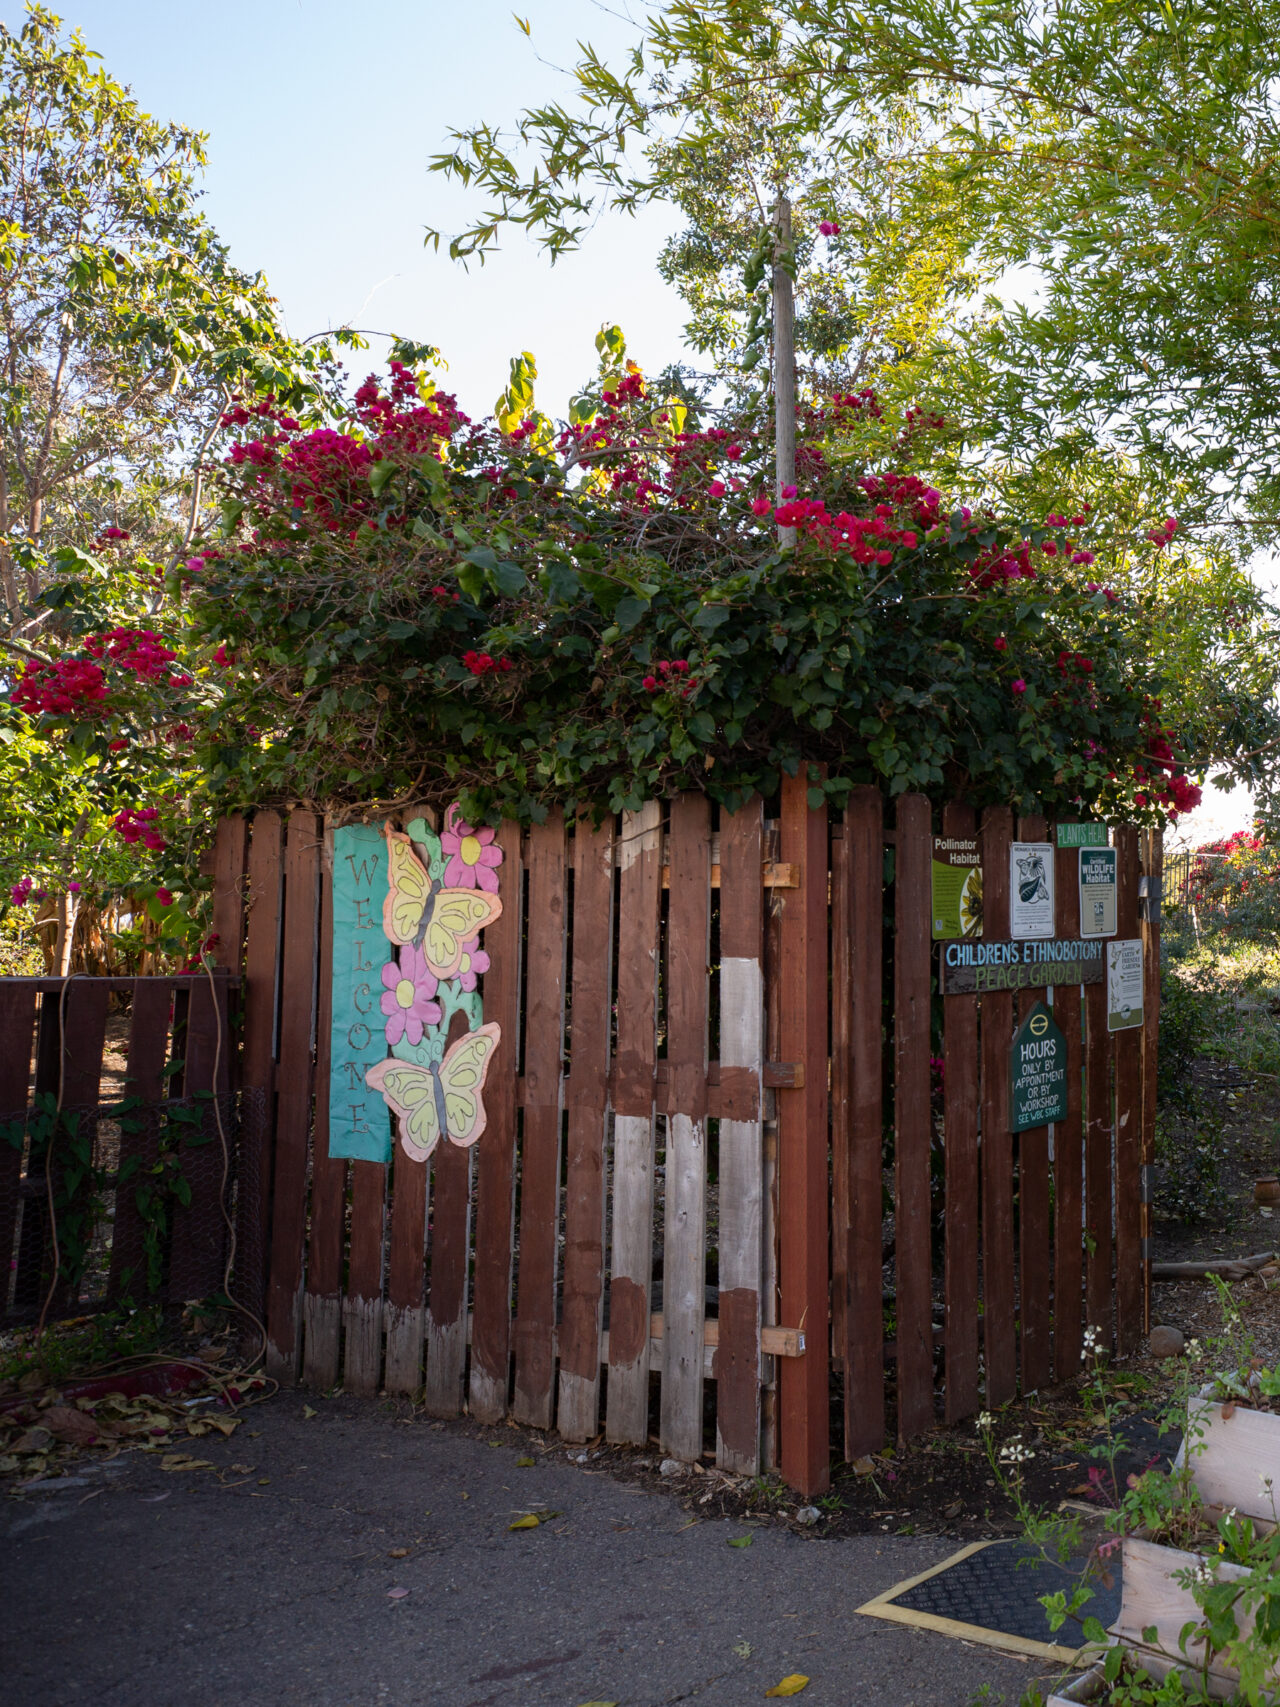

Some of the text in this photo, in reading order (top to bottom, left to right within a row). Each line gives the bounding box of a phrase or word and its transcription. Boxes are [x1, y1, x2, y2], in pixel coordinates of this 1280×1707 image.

[1057, 823, 1107, 845] PLANTS HEAL
[935, 838, 977, 850] Pollinator
[949, 852, 981, 864] Habitat
[1082, 864, 1115, 874] WILDLIFE
[1086, 874, 1111, 883] Habitat
[946, 943, 1020, 967] CHILDREN'S
[976, 961, 1083, 990] PEACE GARDEN
[345, 854, 379, 1134] WELCOME
[1020, 1039, 1057, 1061] HOURS
[1021, 1059, 1055, 1076] ONLY BY
[1015, 1069, 1065, 1089] APPOINTMENT
[1027, 1084, 1051, 1099] OR BY
[1020, 1094, 1059, 1113] WORKSHOP
[1018, 1105, 1061, 1124] SEE WBC STAFF
